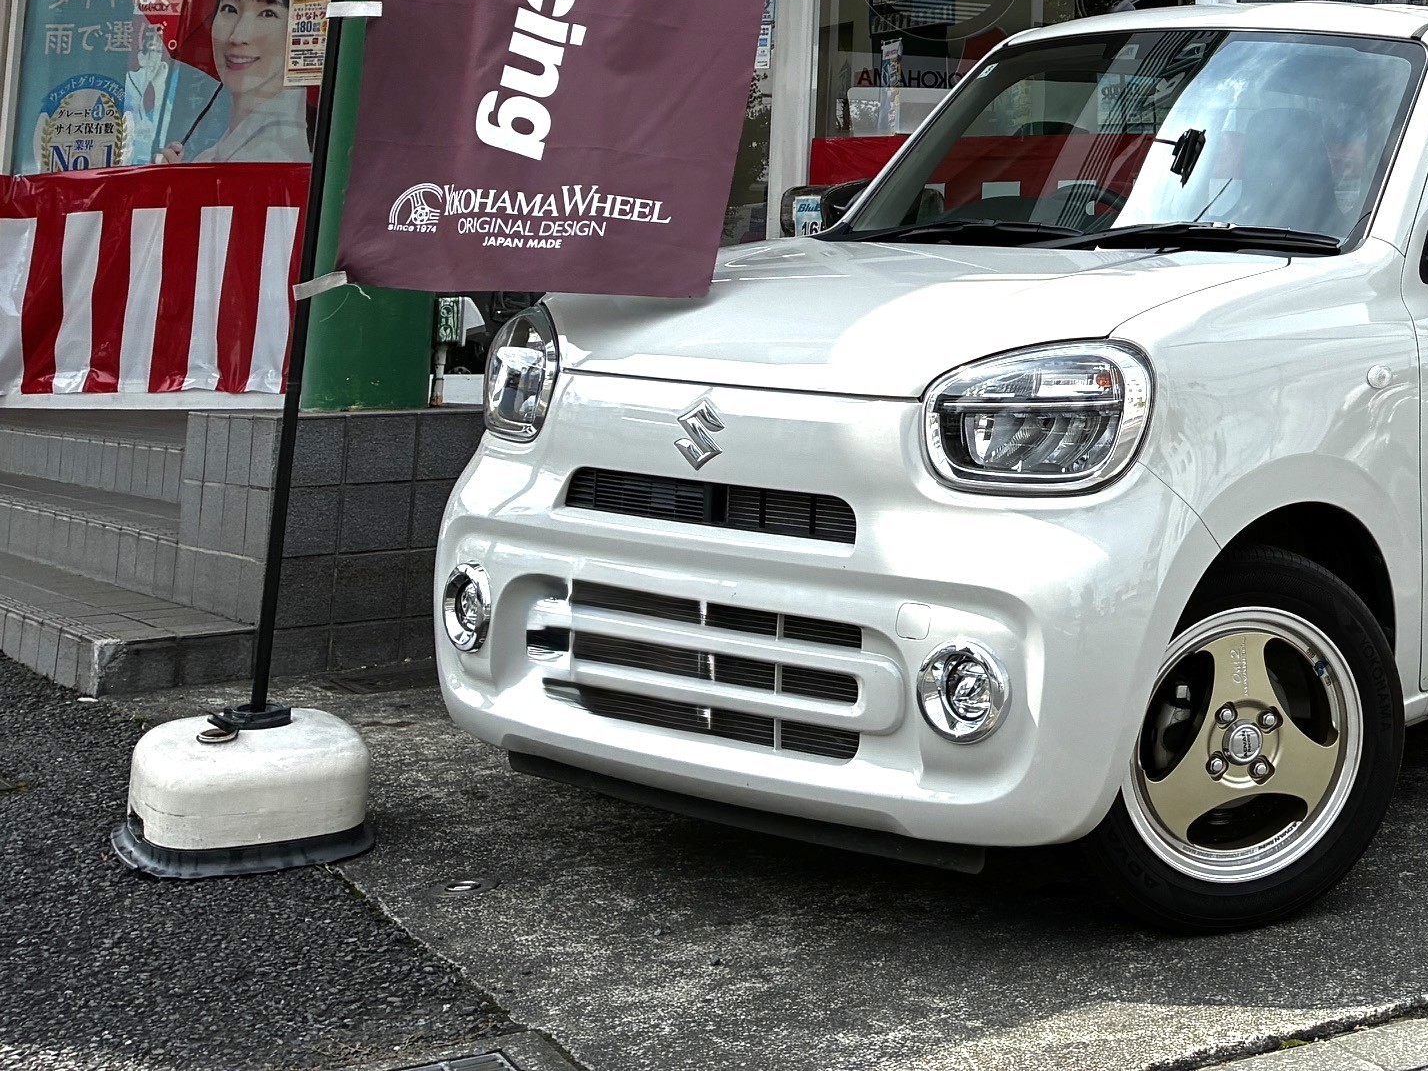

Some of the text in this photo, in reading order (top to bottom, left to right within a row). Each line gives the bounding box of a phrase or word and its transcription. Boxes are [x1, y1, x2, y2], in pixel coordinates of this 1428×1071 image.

[54, 123, 115, 136] サイズ保有数
[443, 184, 672, 224] YOKOHAMA WHEEL
[387, 224, 437, 233] since 1974
[457, 217, 607, 237] ORIGINAL DESIGN
[482, 236, 562, 249] JAPAN MADE
